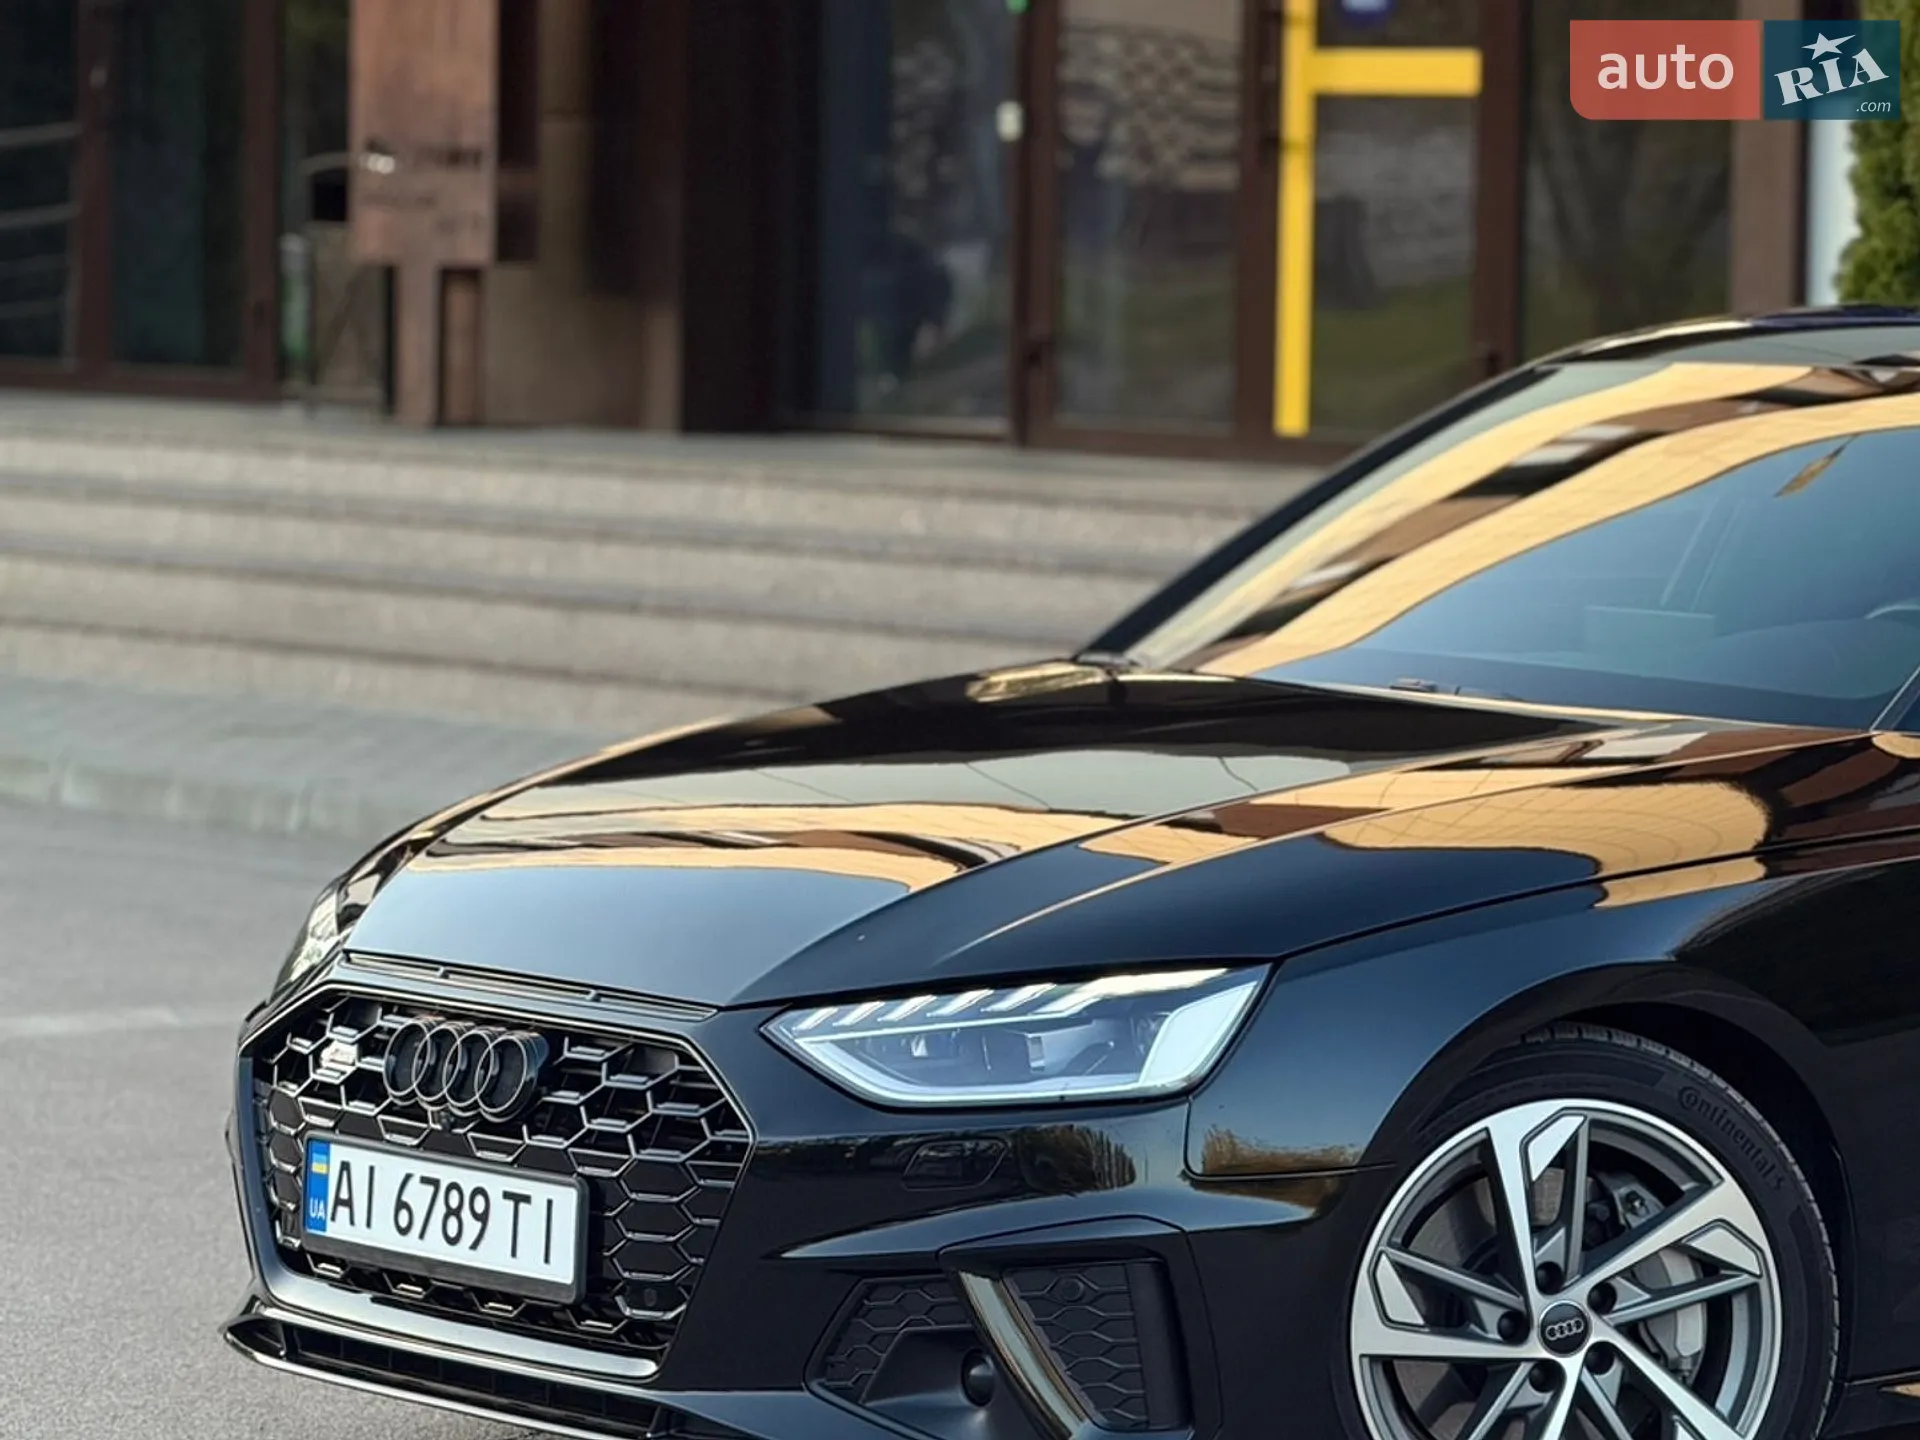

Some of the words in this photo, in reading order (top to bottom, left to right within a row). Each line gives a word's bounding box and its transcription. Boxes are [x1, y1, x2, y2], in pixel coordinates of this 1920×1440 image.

[1677, 1086, 1776, 1180] Continental
[309, 1199, 326, 1219] UA
[330, 1160, 375, 1230] AI
[393, 1172, 491, 1251] 6789
[502, 1190, 554, 1265] TI
